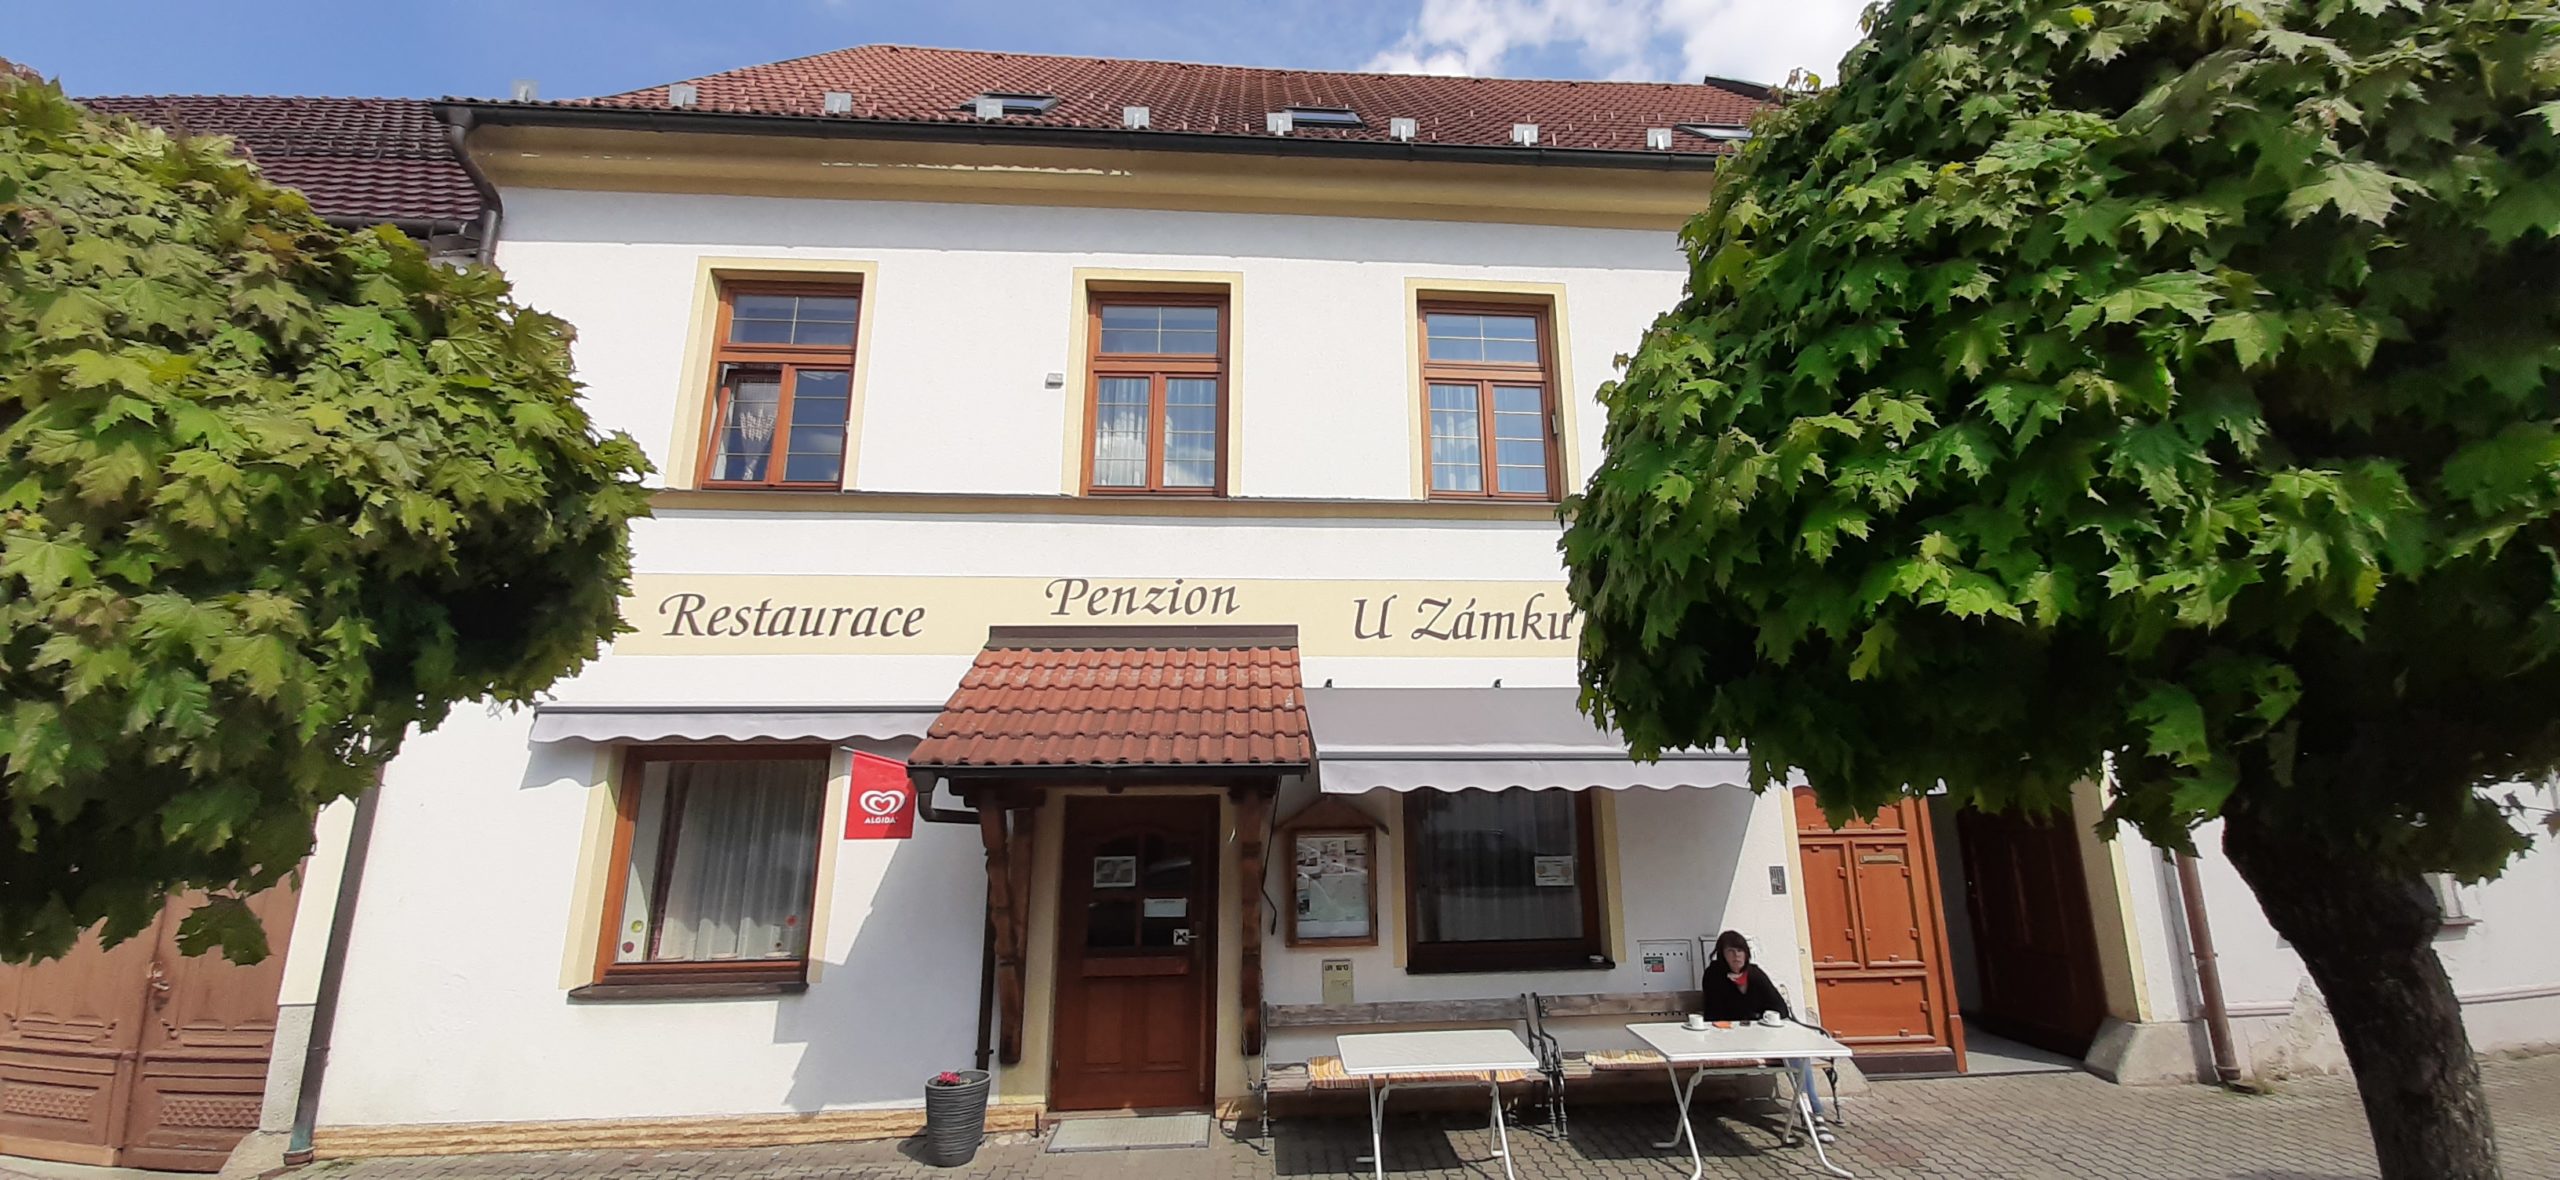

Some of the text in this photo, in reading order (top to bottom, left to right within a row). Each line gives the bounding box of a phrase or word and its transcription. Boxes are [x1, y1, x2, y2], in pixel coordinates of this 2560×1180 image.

[658, 592, 926, 638] Restaurace
[1045, 577, 1241, 616] Penzion
[1353, 592, 1573, 641] U Zámku
[863, 816, 897, 824] ALGIDA
